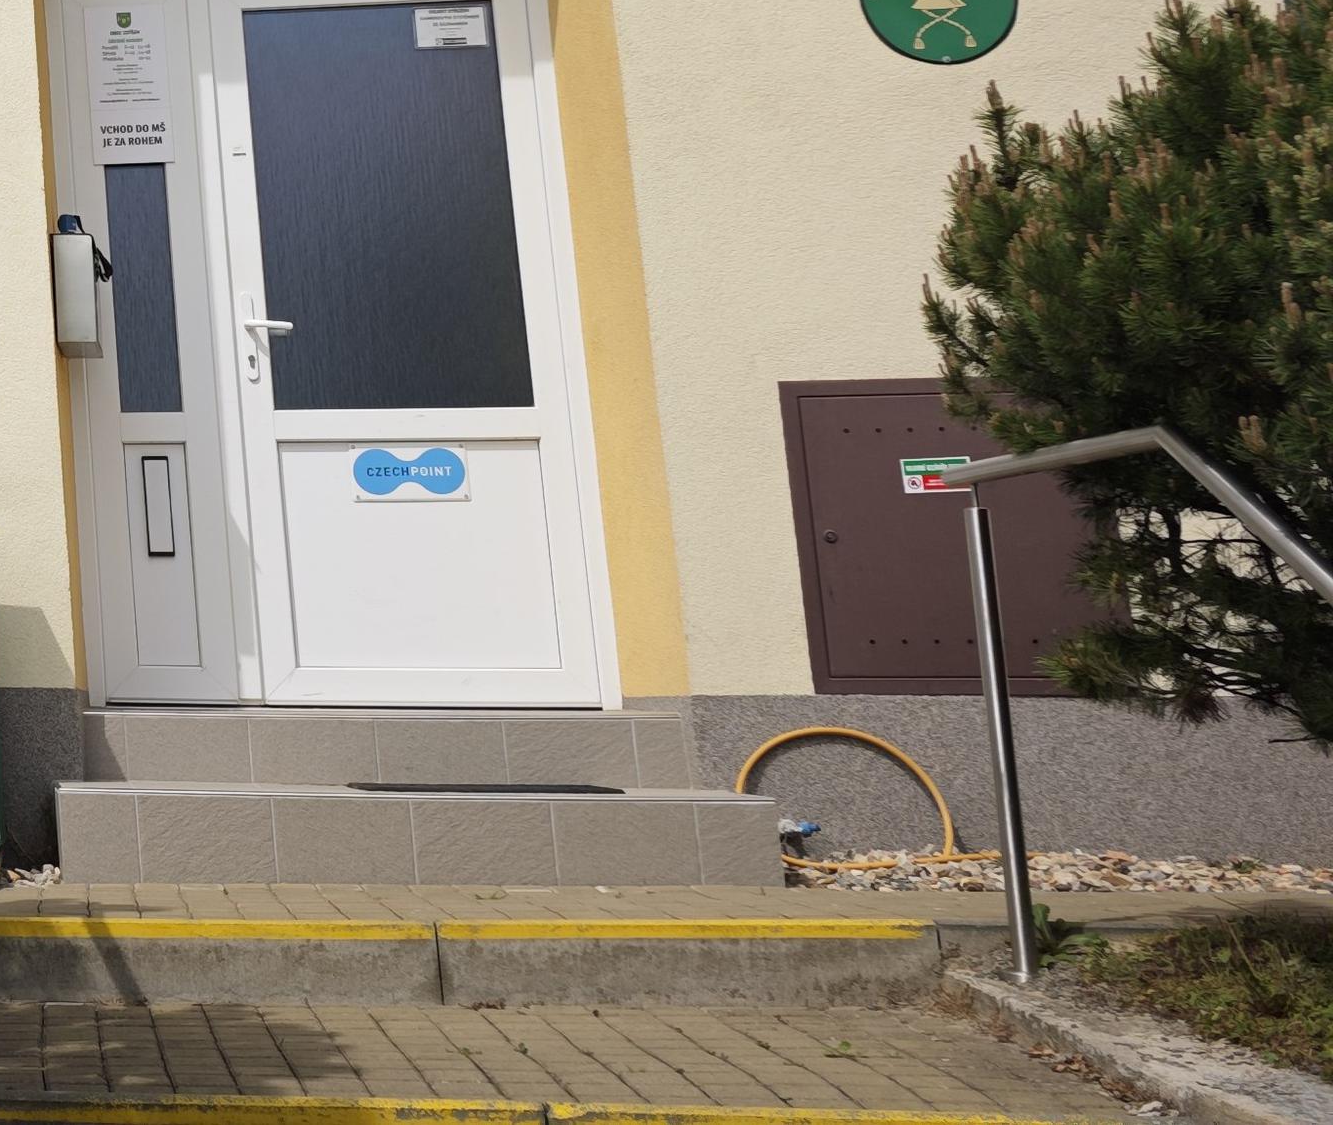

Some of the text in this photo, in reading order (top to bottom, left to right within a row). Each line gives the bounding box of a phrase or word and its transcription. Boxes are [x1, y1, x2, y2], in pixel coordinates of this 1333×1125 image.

[100, 122, 166, 135] VCHOD DO MŠ
[103, 136, 163, 147] JE ZA ROHEM
